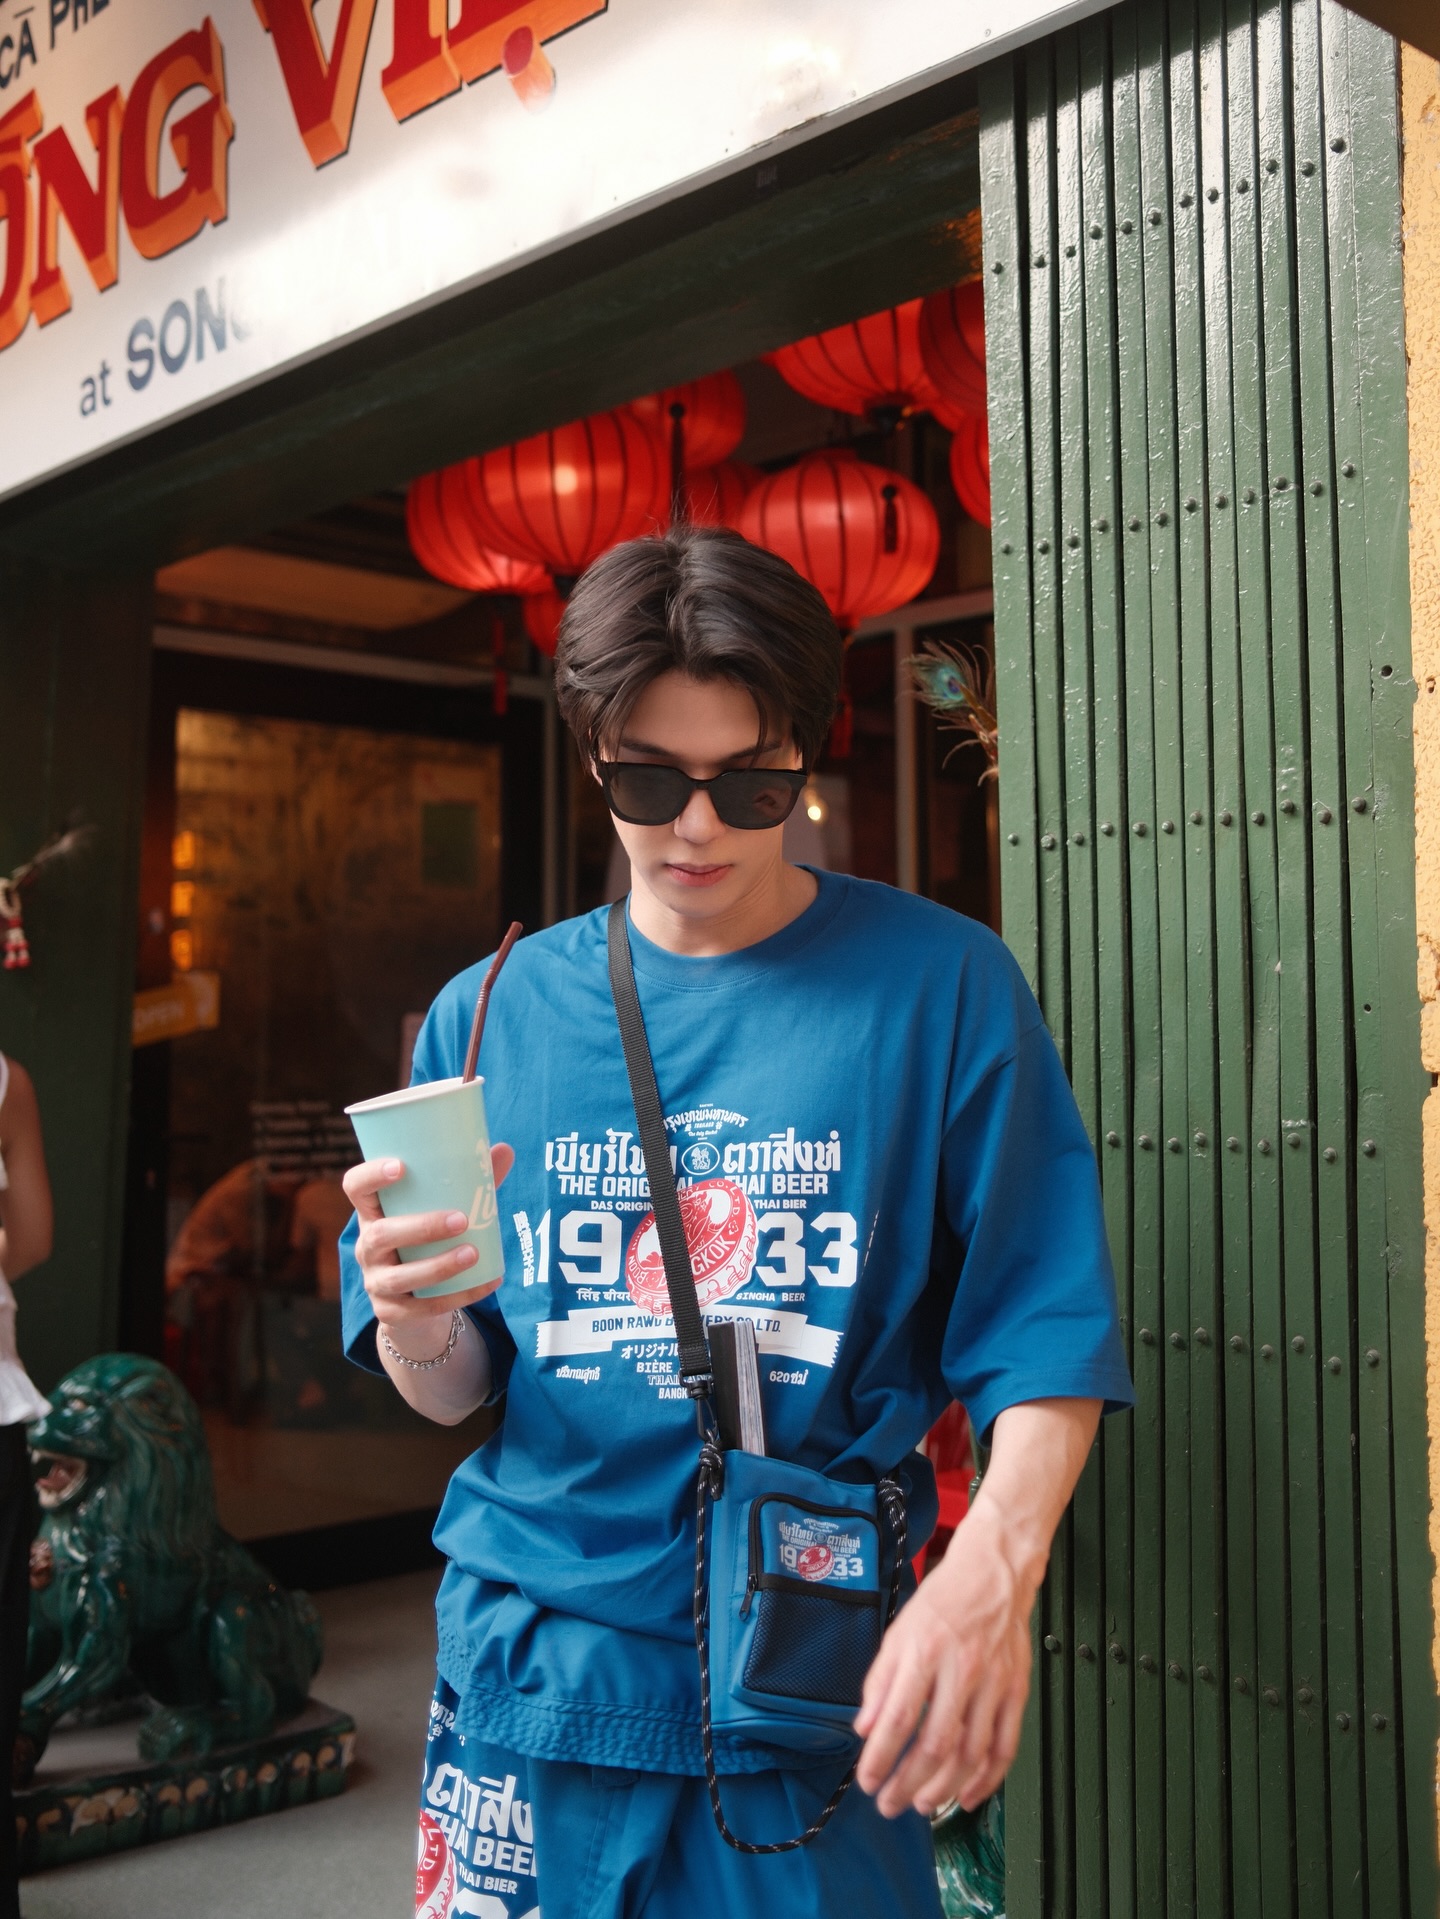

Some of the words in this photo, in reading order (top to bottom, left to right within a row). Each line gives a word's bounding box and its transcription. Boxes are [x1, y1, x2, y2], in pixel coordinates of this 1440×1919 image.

[80, 360, 111, 416] at
[722, 1127, 841, 1174] ตราสิงห์
[558, 1174, 597, 1195] THE
[772, 1173, 828, 1194] BEER
[591, 1200, 613, 1211] DAS
[754, 1199, 780, 1209] THAI
[783, 1199, 807, 1209] BIER
[735, 1292, 775, 1302] SINGHA
[781, 1292, 806, 1302] BEER
[592, 1319, 624, 1333] BOON
[636, 1359, 673, 1373] BIÈRE
[459, 1861, 481, 1888] THAI
[484, 1876, 518, 1895] BIER
